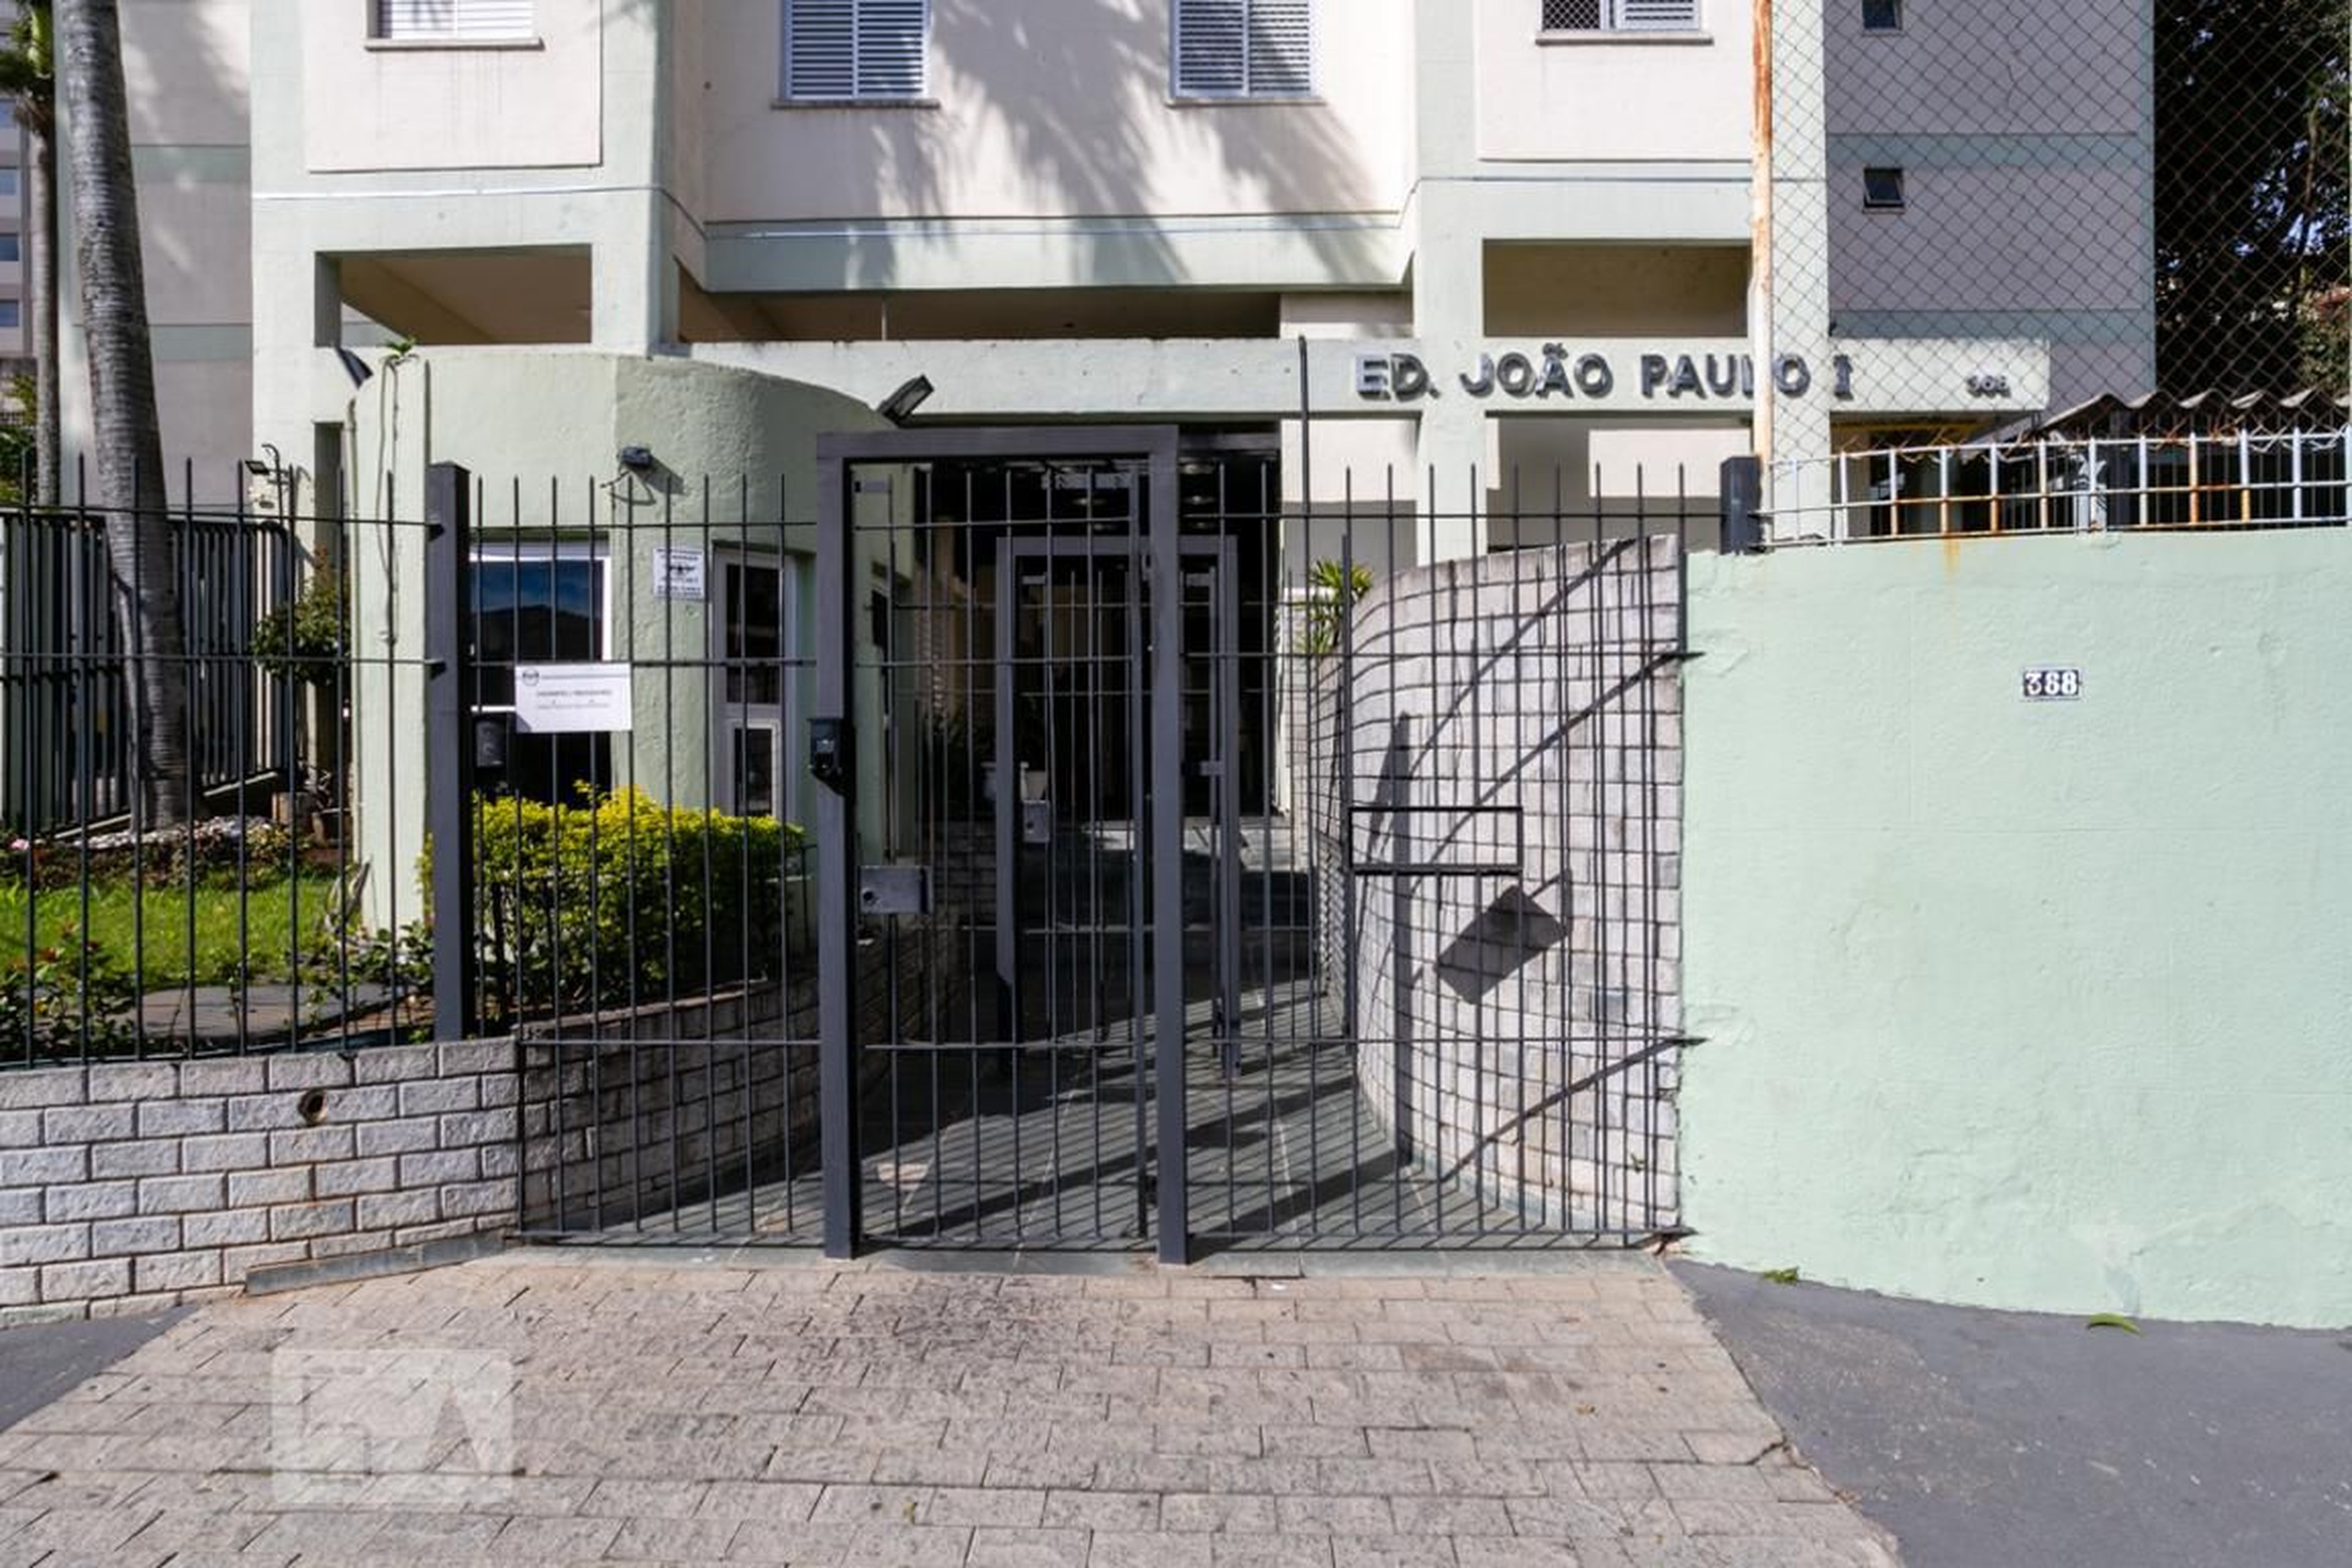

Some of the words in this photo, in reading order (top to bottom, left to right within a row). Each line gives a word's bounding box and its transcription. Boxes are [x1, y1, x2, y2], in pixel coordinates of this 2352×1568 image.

[1355, 353, 1441, 402] ED.
[1460, 342, 1615, 399] JOÃO
[2025, 670, 2078, 696] 388
